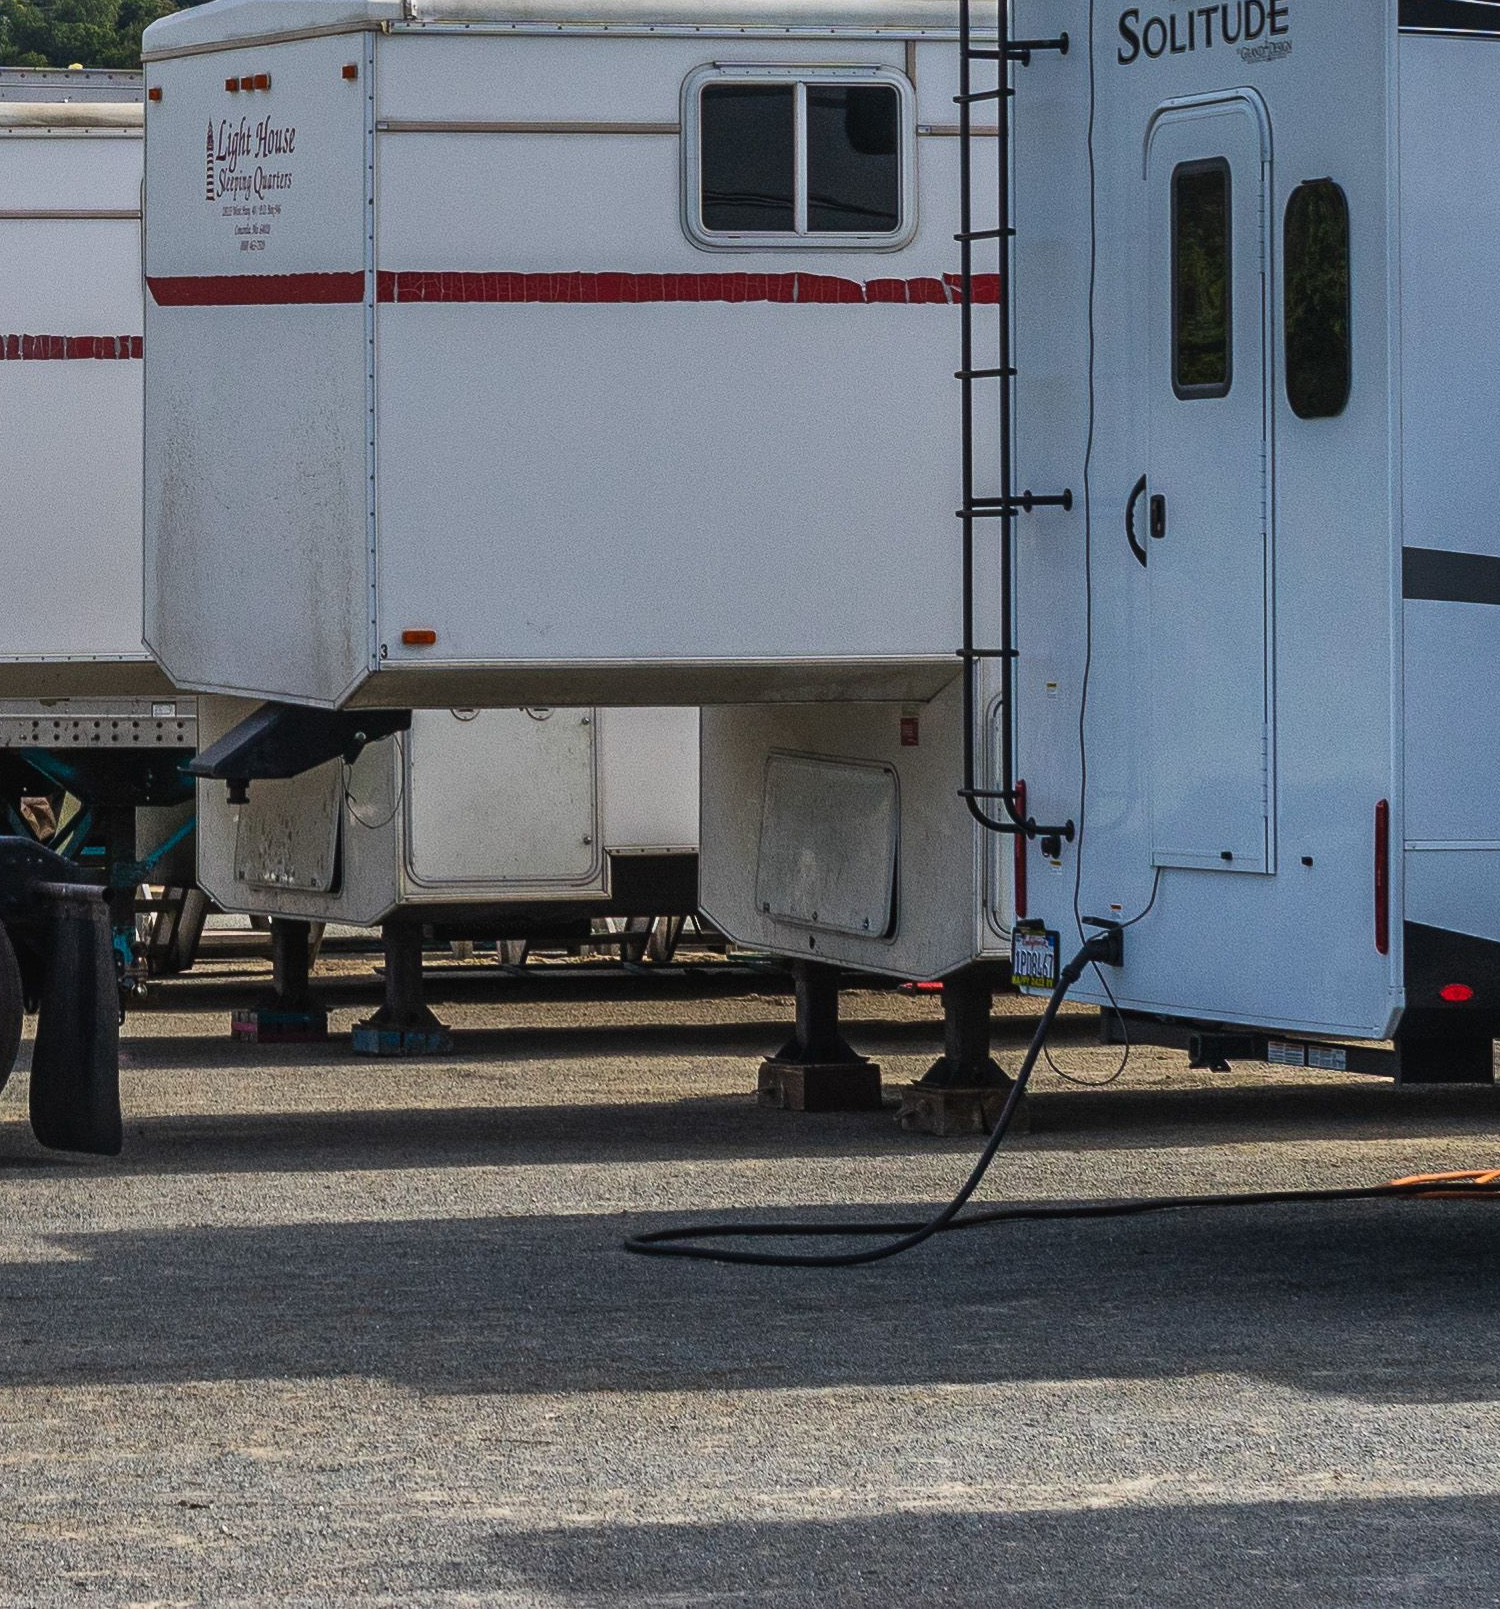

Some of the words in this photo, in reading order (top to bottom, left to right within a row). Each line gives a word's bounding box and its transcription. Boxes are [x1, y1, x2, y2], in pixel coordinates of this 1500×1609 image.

[215, 116, 252, 173] Light
[254, 115, 296, 159] House
[216, 167, 253, 201] Sleeping
[253, 165, 293, 201] Quarters
[380, 643, 388, 659] 3
